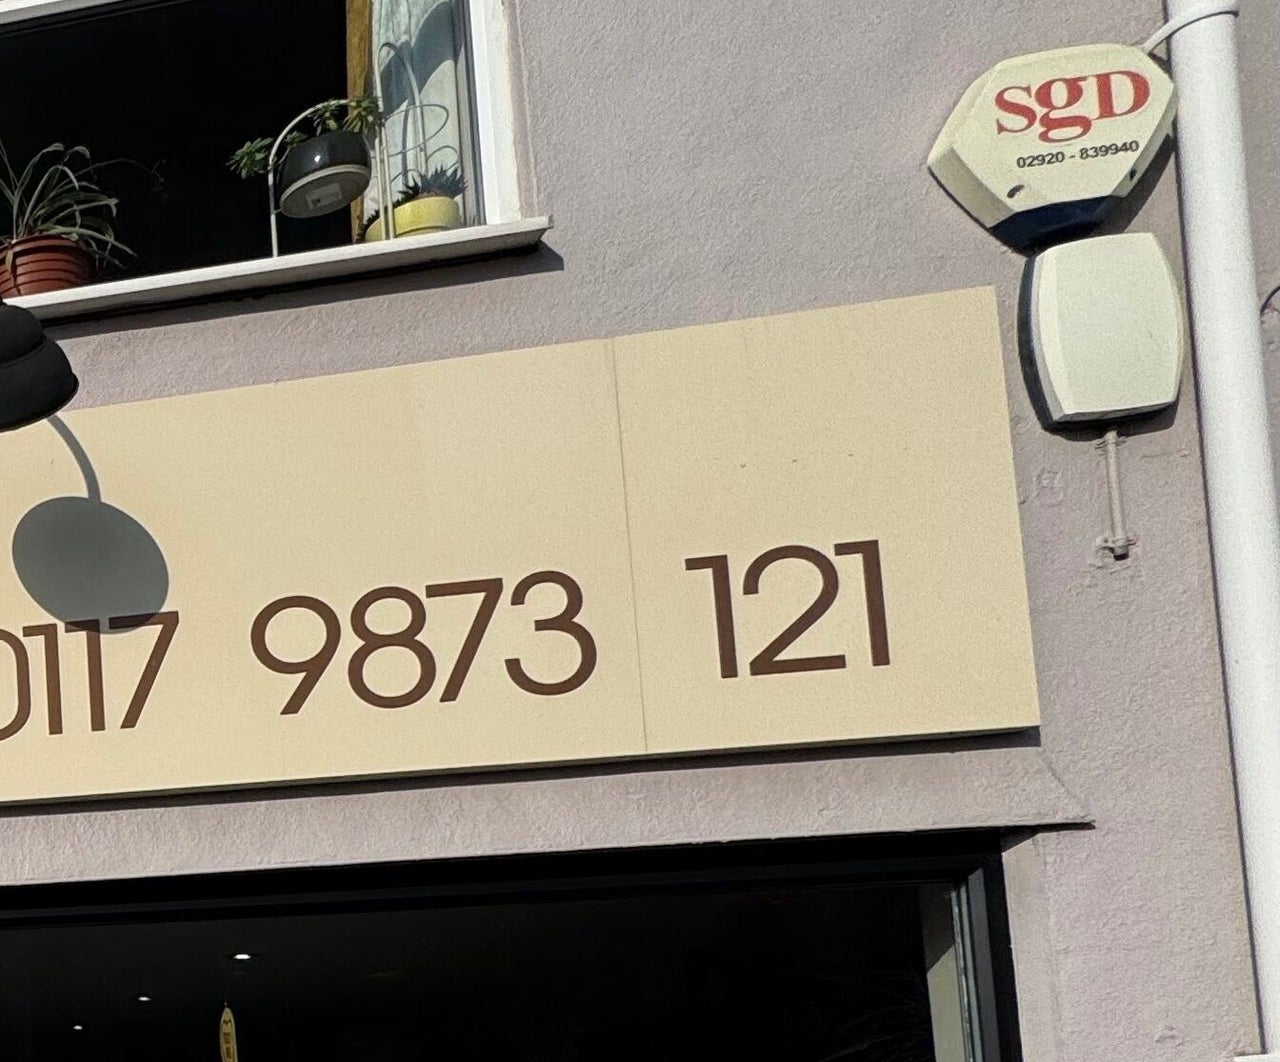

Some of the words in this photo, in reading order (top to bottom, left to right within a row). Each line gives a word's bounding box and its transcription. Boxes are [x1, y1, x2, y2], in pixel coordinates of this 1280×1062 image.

[1016, 151, 1065, 169] 02920
[1079, 140, 1140, 160] 839940
[250, 570, 597, 716] 9873
[684, 539, 891, 680] 121
